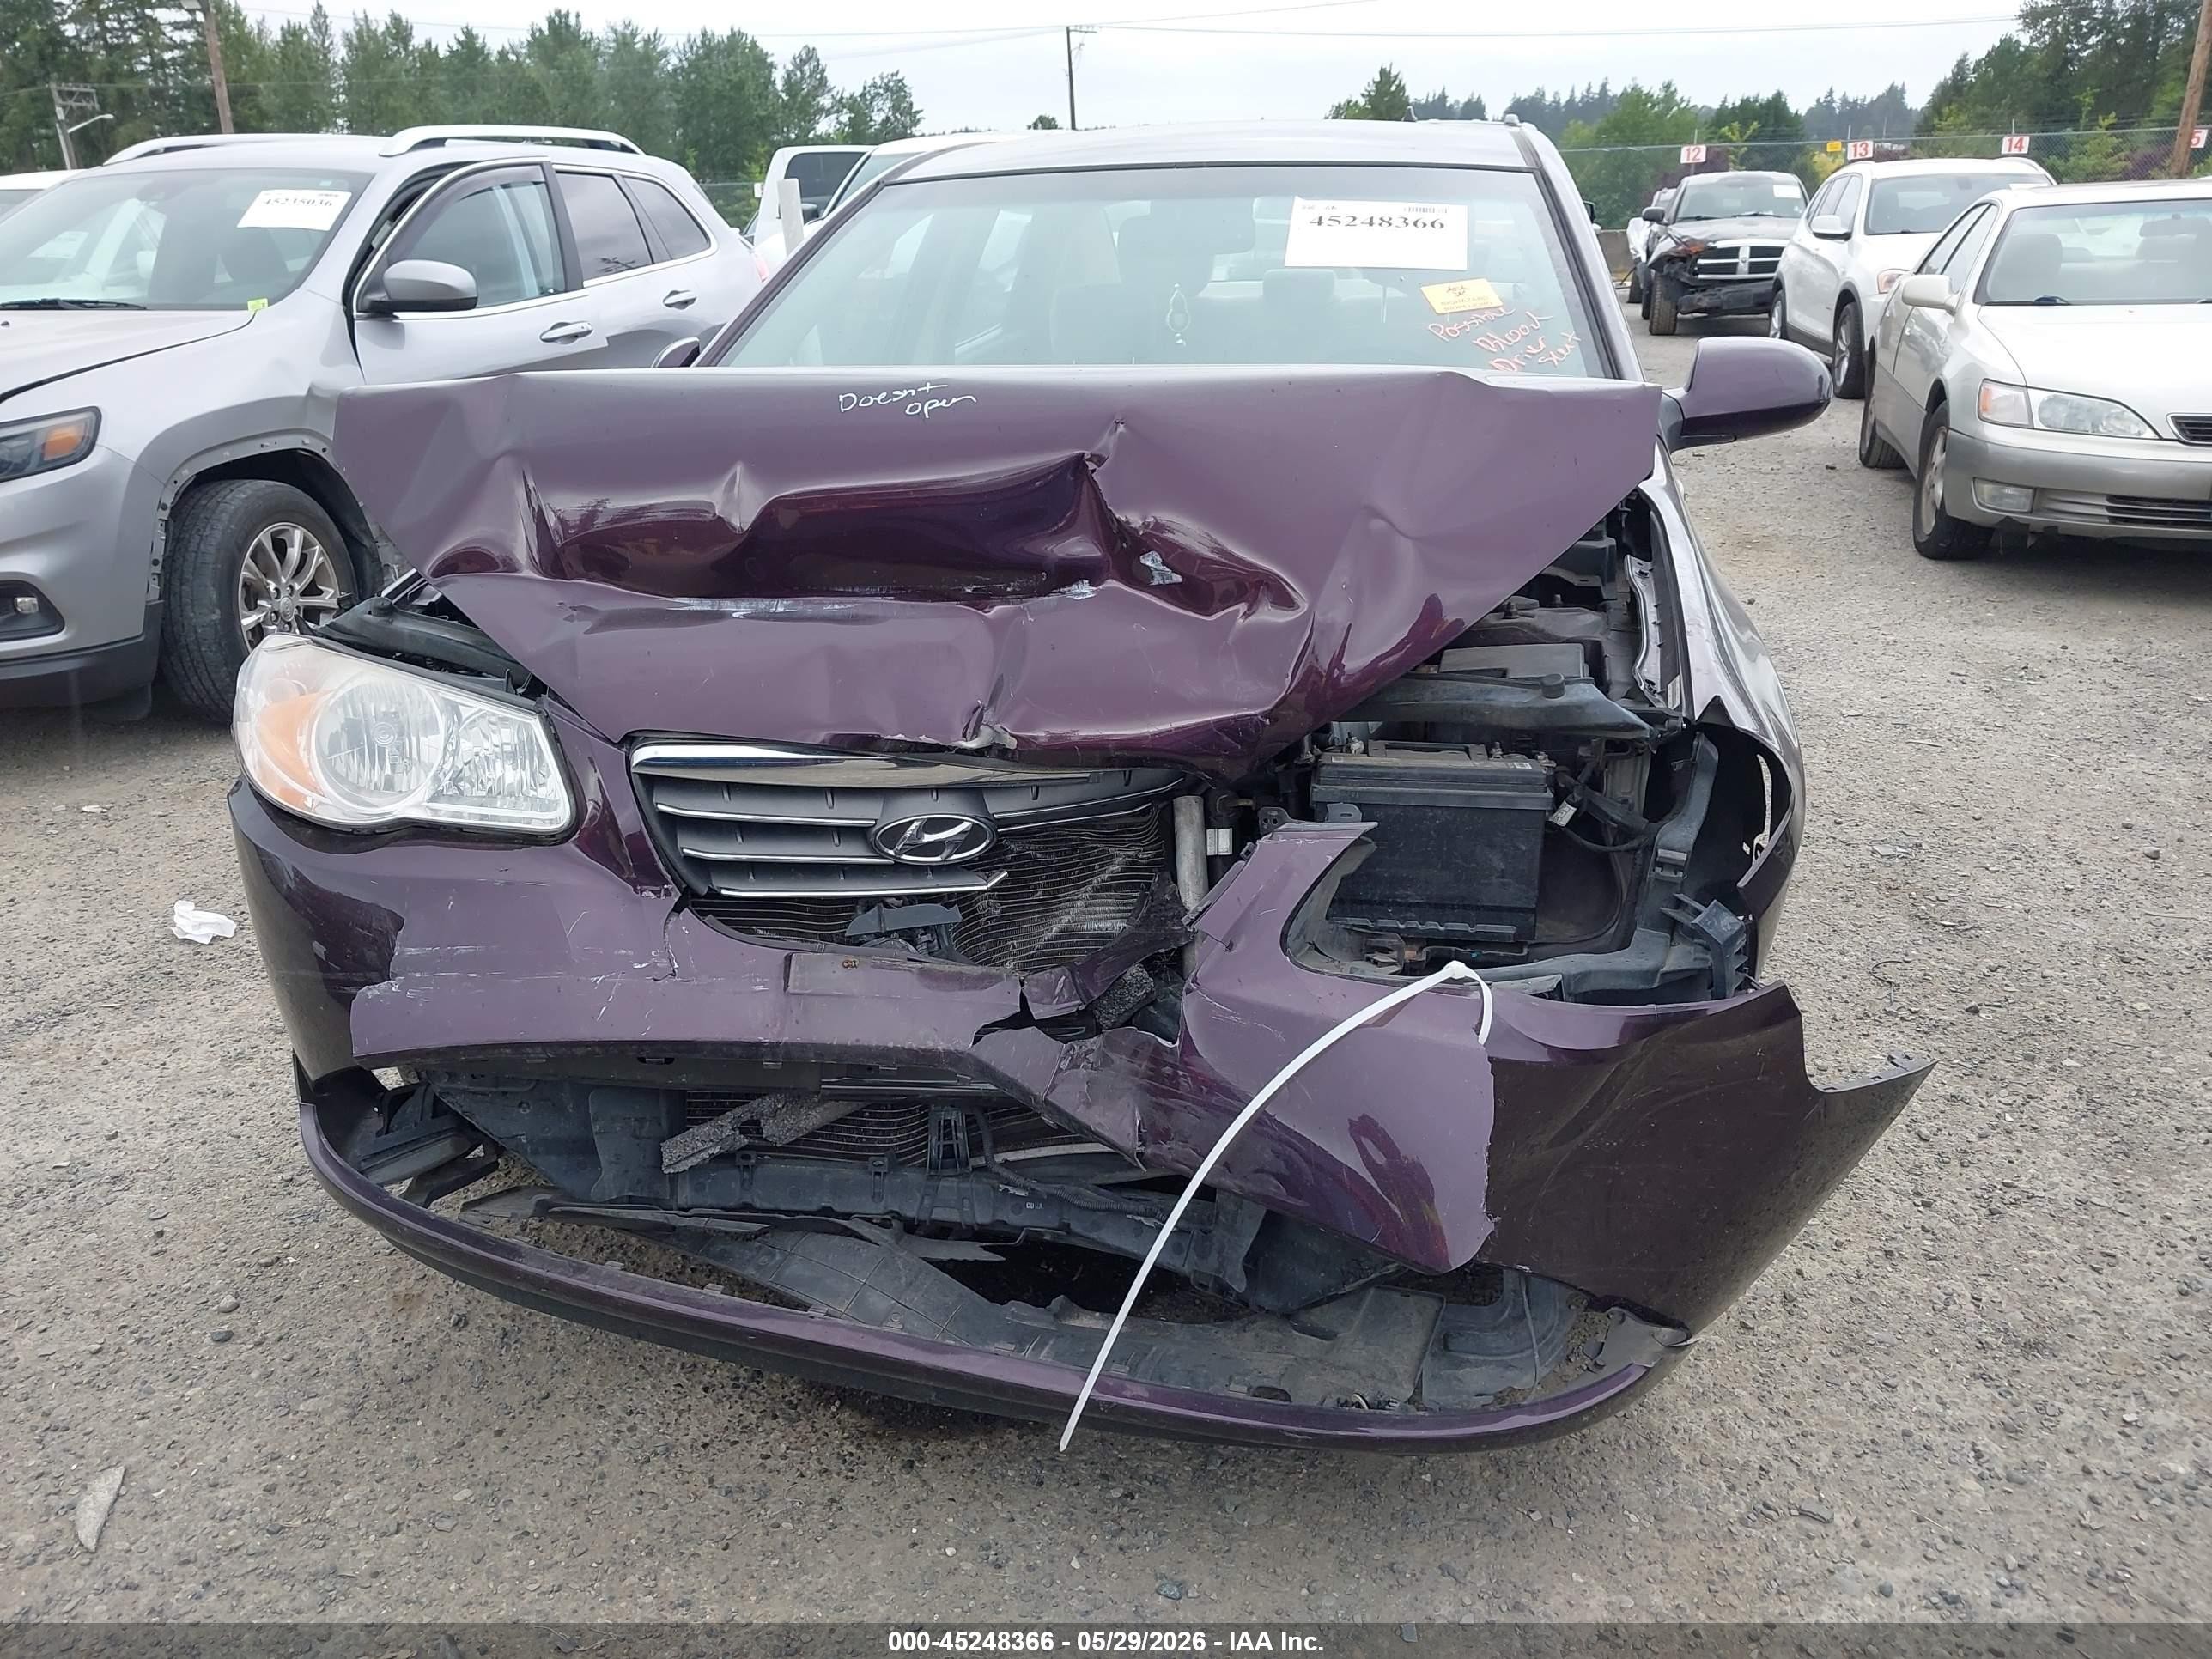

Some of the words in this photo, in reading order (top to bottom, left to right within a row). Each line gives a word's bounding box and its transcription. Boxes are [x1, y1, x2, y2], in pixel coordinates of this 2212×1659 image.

[2007, 137, 2025, 152] 14
[2191, 131, 2203, 146] 5
[1686, 148, 1701, 161] 12
[1852, 143, 1869, 157] 13
[1309, 215, 1445, 229] 45248366
[905, 396, 977, 419] open
